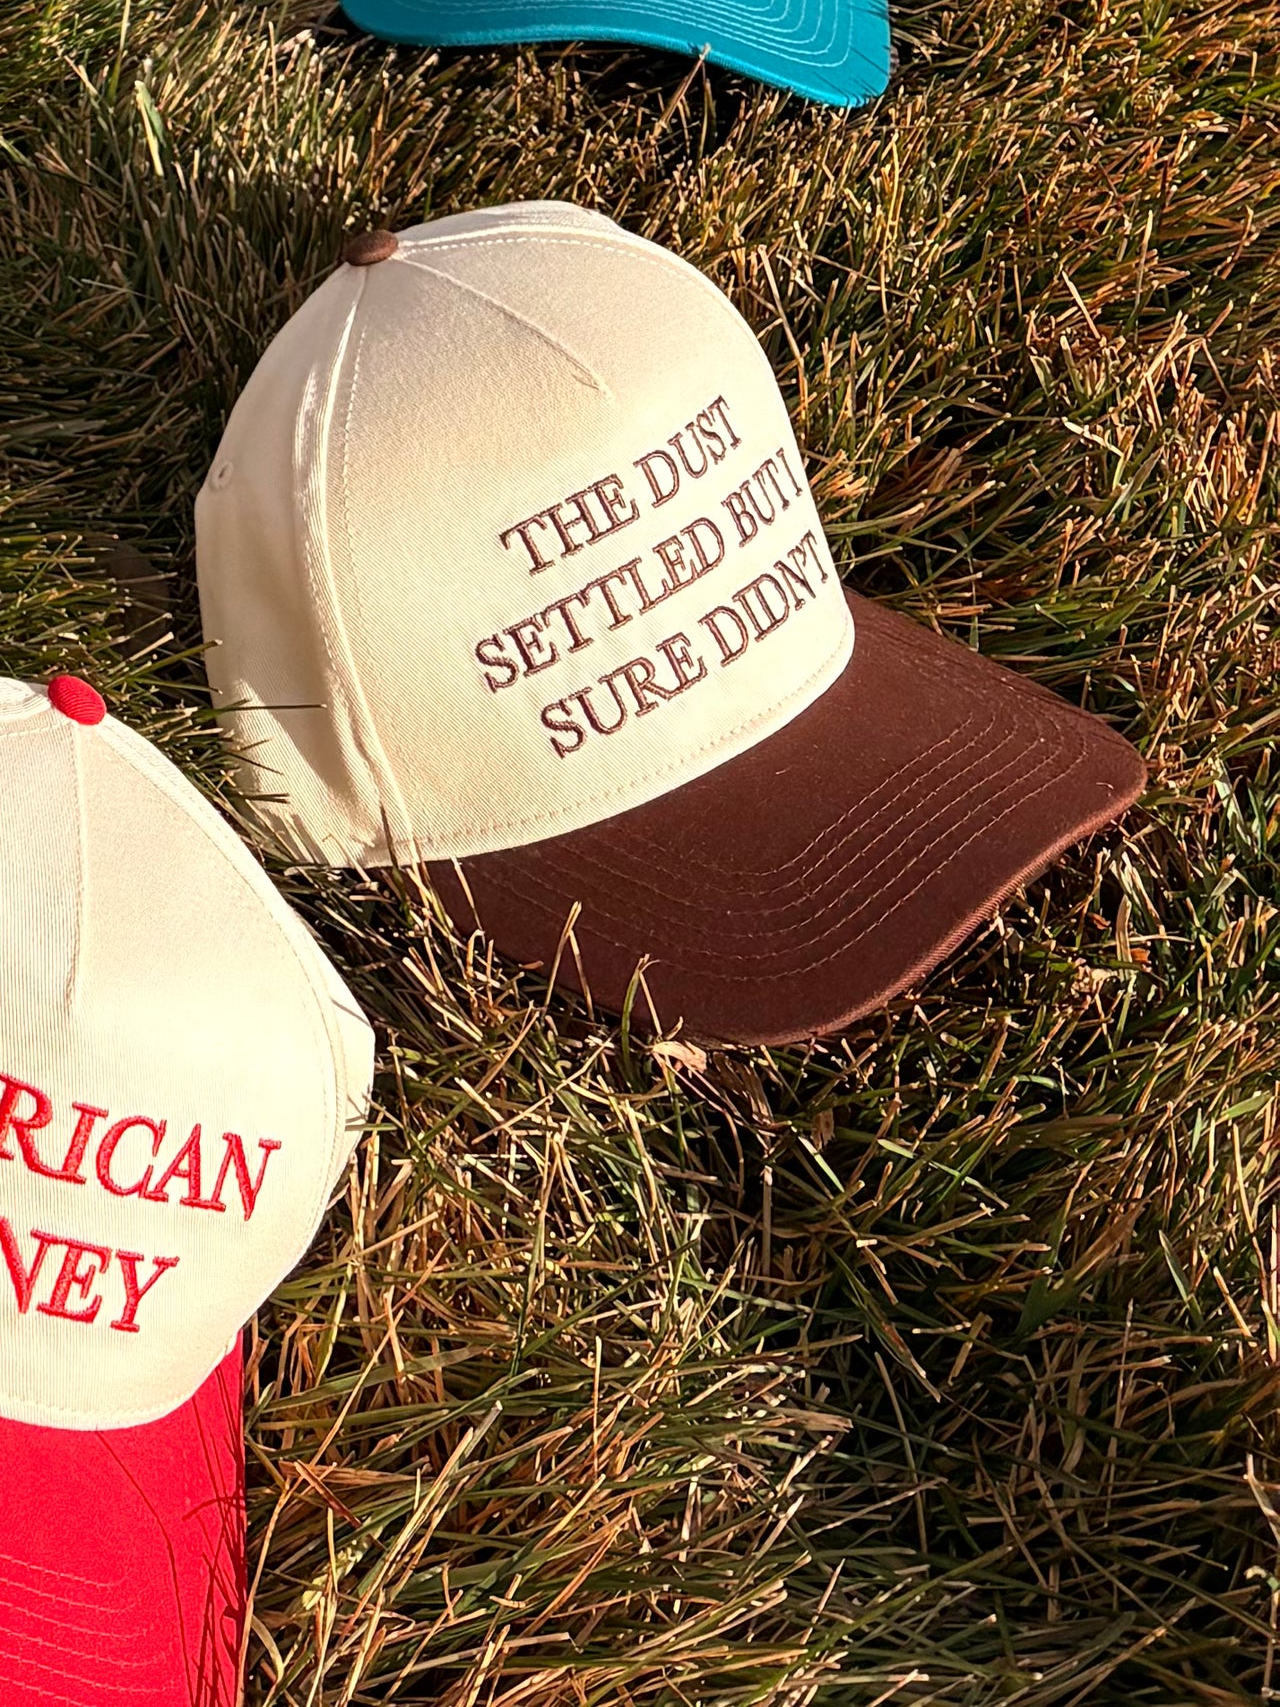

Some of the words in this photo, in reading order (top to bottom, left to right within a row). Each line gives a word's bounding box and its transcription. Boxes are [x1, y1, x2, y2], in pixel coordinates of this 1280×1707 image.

[474, 516, 726, 693] SETTLED
[721, 457, 792, 548] BUT
[775, 448, 803, 497] I
[498, 473, 640, 576] THE
[632, 394, 742, 509] DUST
[539, 631, 708, 759] SURE
[698, 530, 829, 668] DIDN'T
